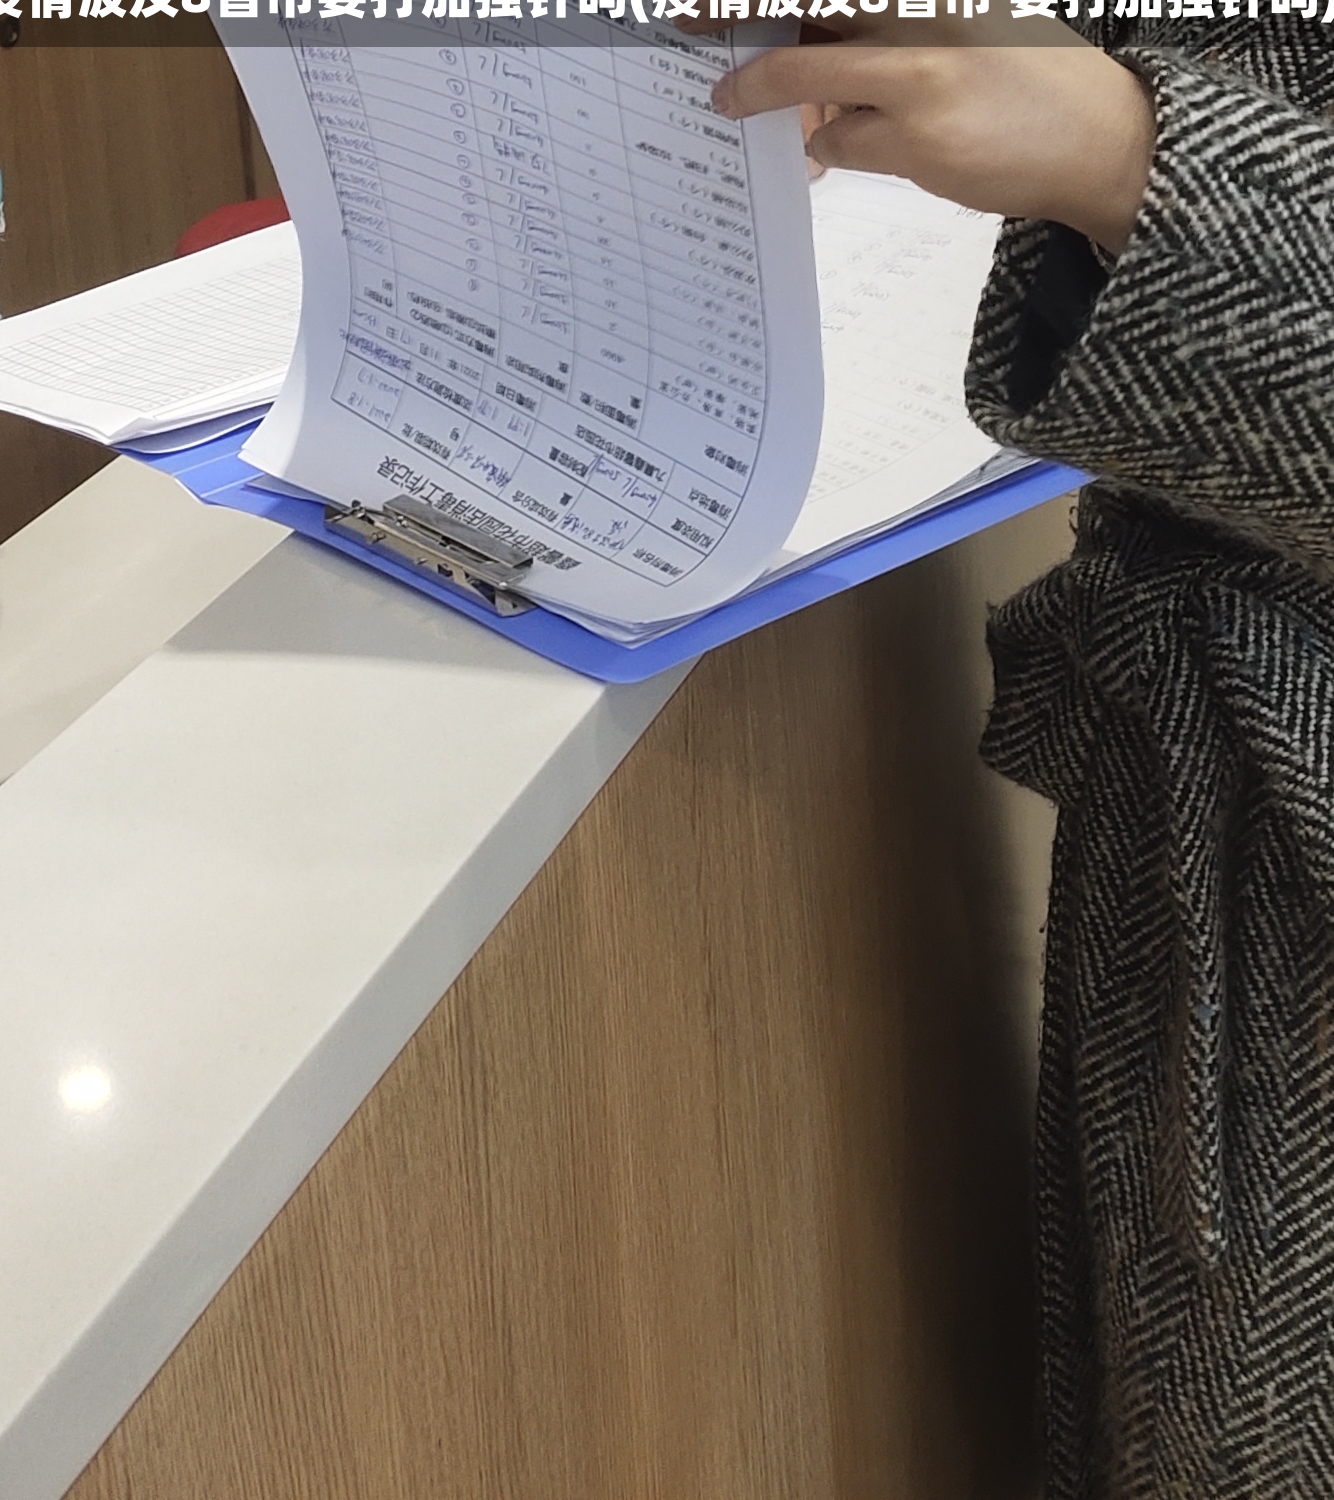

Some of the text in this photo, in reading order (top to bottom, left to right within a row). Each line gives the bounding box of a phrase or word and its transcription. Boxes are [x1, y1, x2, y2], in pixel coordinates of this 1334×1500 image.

[415, 371, 472, 411] 浓度检测方法
[447, 426, 460, 440] 号
[547, 446, 588, 477] 配制容量
[703, 444, 748, 476] 消毒对象
[511, 490, 559, 523] 有效成分含
[559, 492, 572, 507] 量
[688, 486, 731, 520] 消毒地点
[672, 518, 715, 549] 拟用浓度
[631, 546, 686, 578] 消毒剂名称
